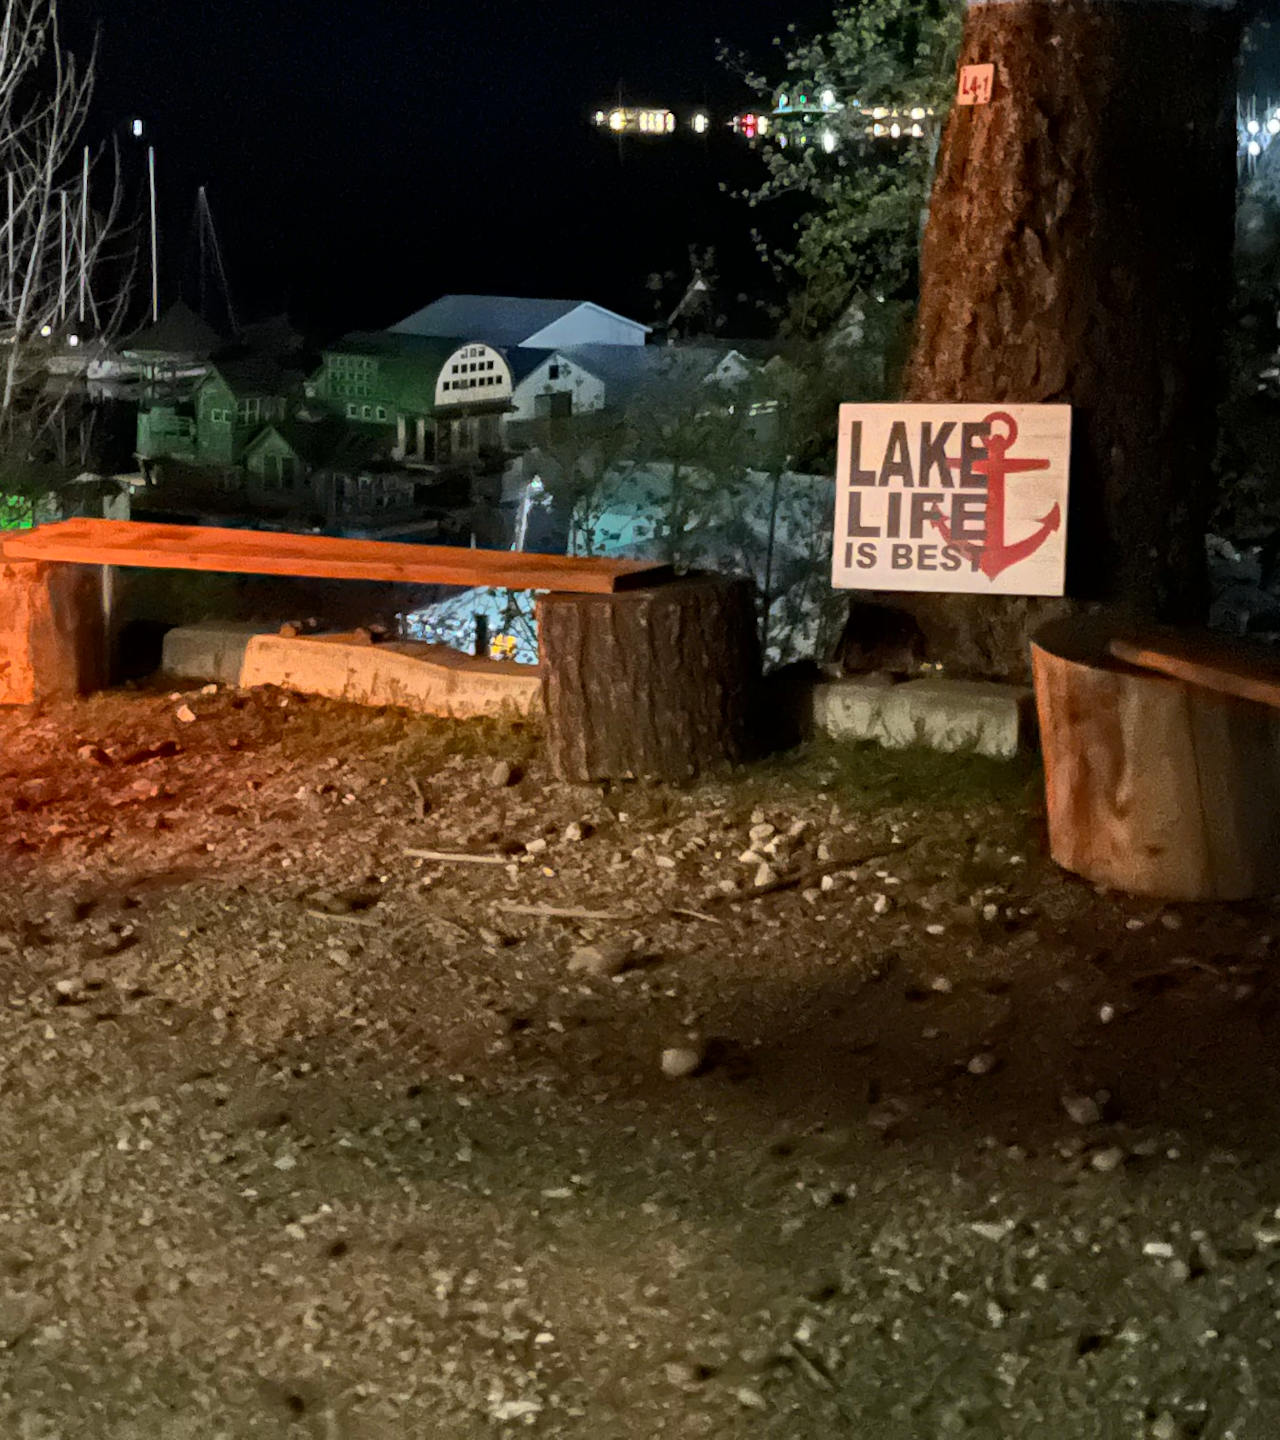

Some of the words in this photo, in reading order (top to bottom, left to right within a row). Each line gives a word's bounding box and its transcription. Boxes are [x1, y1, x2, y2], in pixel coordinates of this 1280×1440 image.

[848, 420, 991, 489] LAKE
[847, 491, 989, 541] LIFE
[844, 542, 877, 569] IS
[891, 543, 987, 573] BEST
